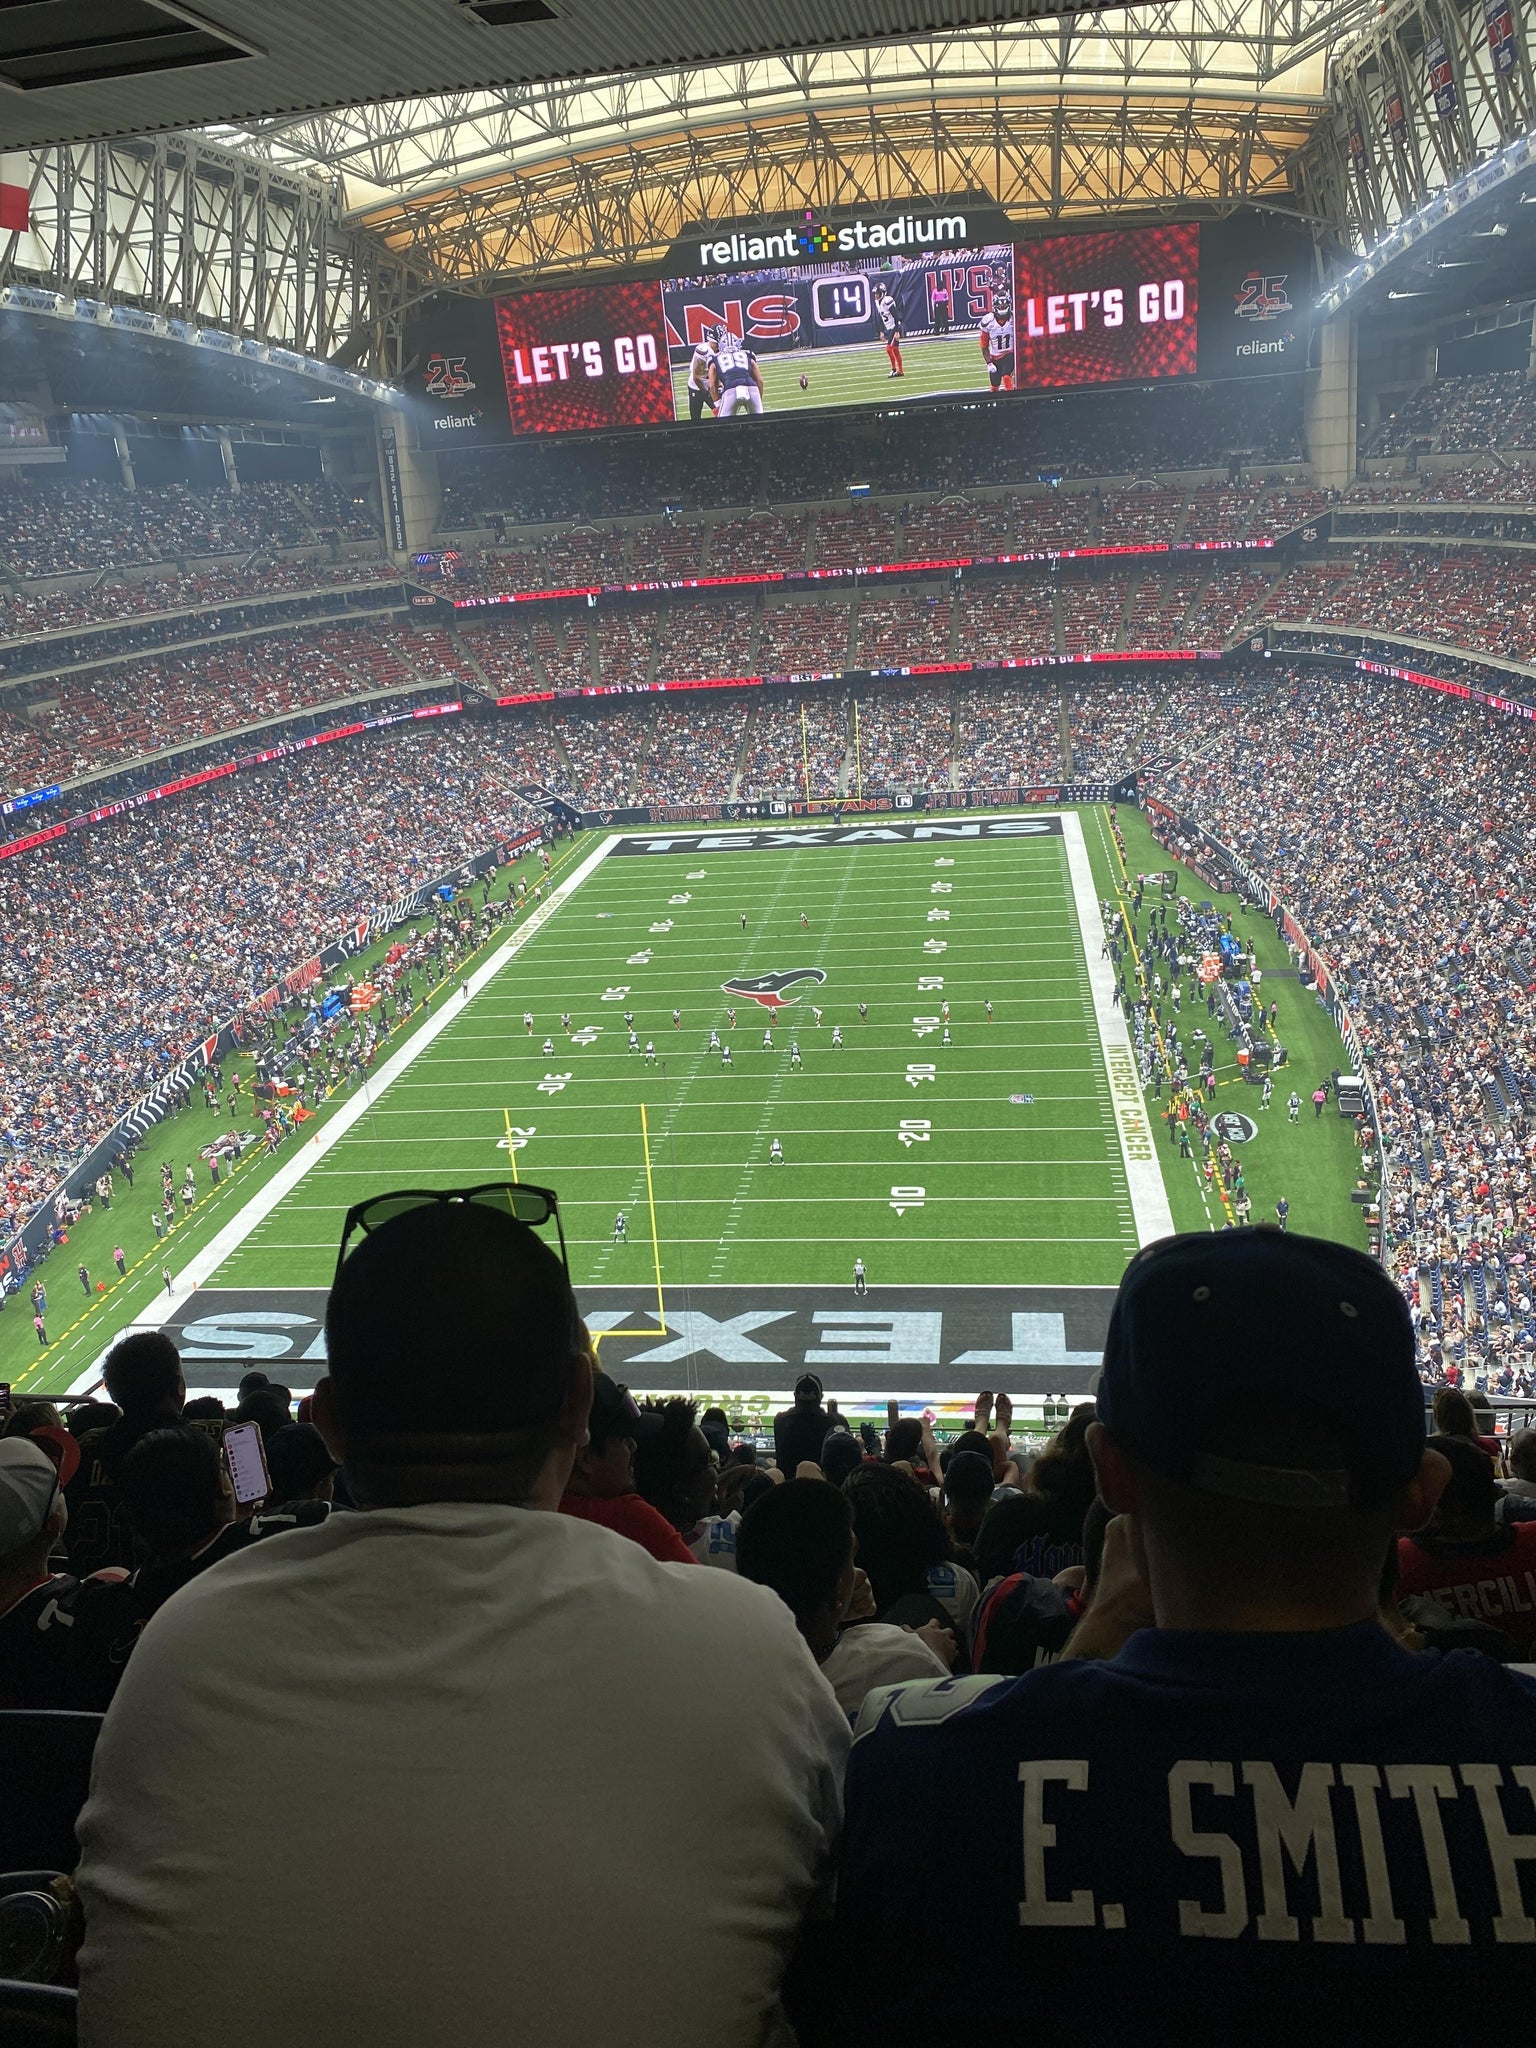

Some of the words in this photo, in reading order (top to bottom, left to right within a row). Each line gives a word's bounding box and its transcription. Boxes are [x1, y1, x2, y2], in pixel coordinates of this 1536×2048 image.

[700, 228, 799, 265] reliant
[838, 213, 966, 251] stadium
[833, 285, 862, 316] 14
[1027, 287, 1125, 338] LET'S
[1138, 280, 1185, 326] GO
[513, 341, 604, 385] LET'S
[613, 334, 658, 374] GO
[1236, 339, 1285, 356] reliant
[434, 414, 477, 430] reliant
[630, 821, 1051, 851] TEXANS
[1106, 1043, 1141, 1109] INTERCEPT
[897, 1119, 931, 1141] 20
[1119, 1109, 1152, 1161] CANCER
[1018, 1758, 1127, 1930] E.
[1167, 1759, 1536, 1946] SMITH
